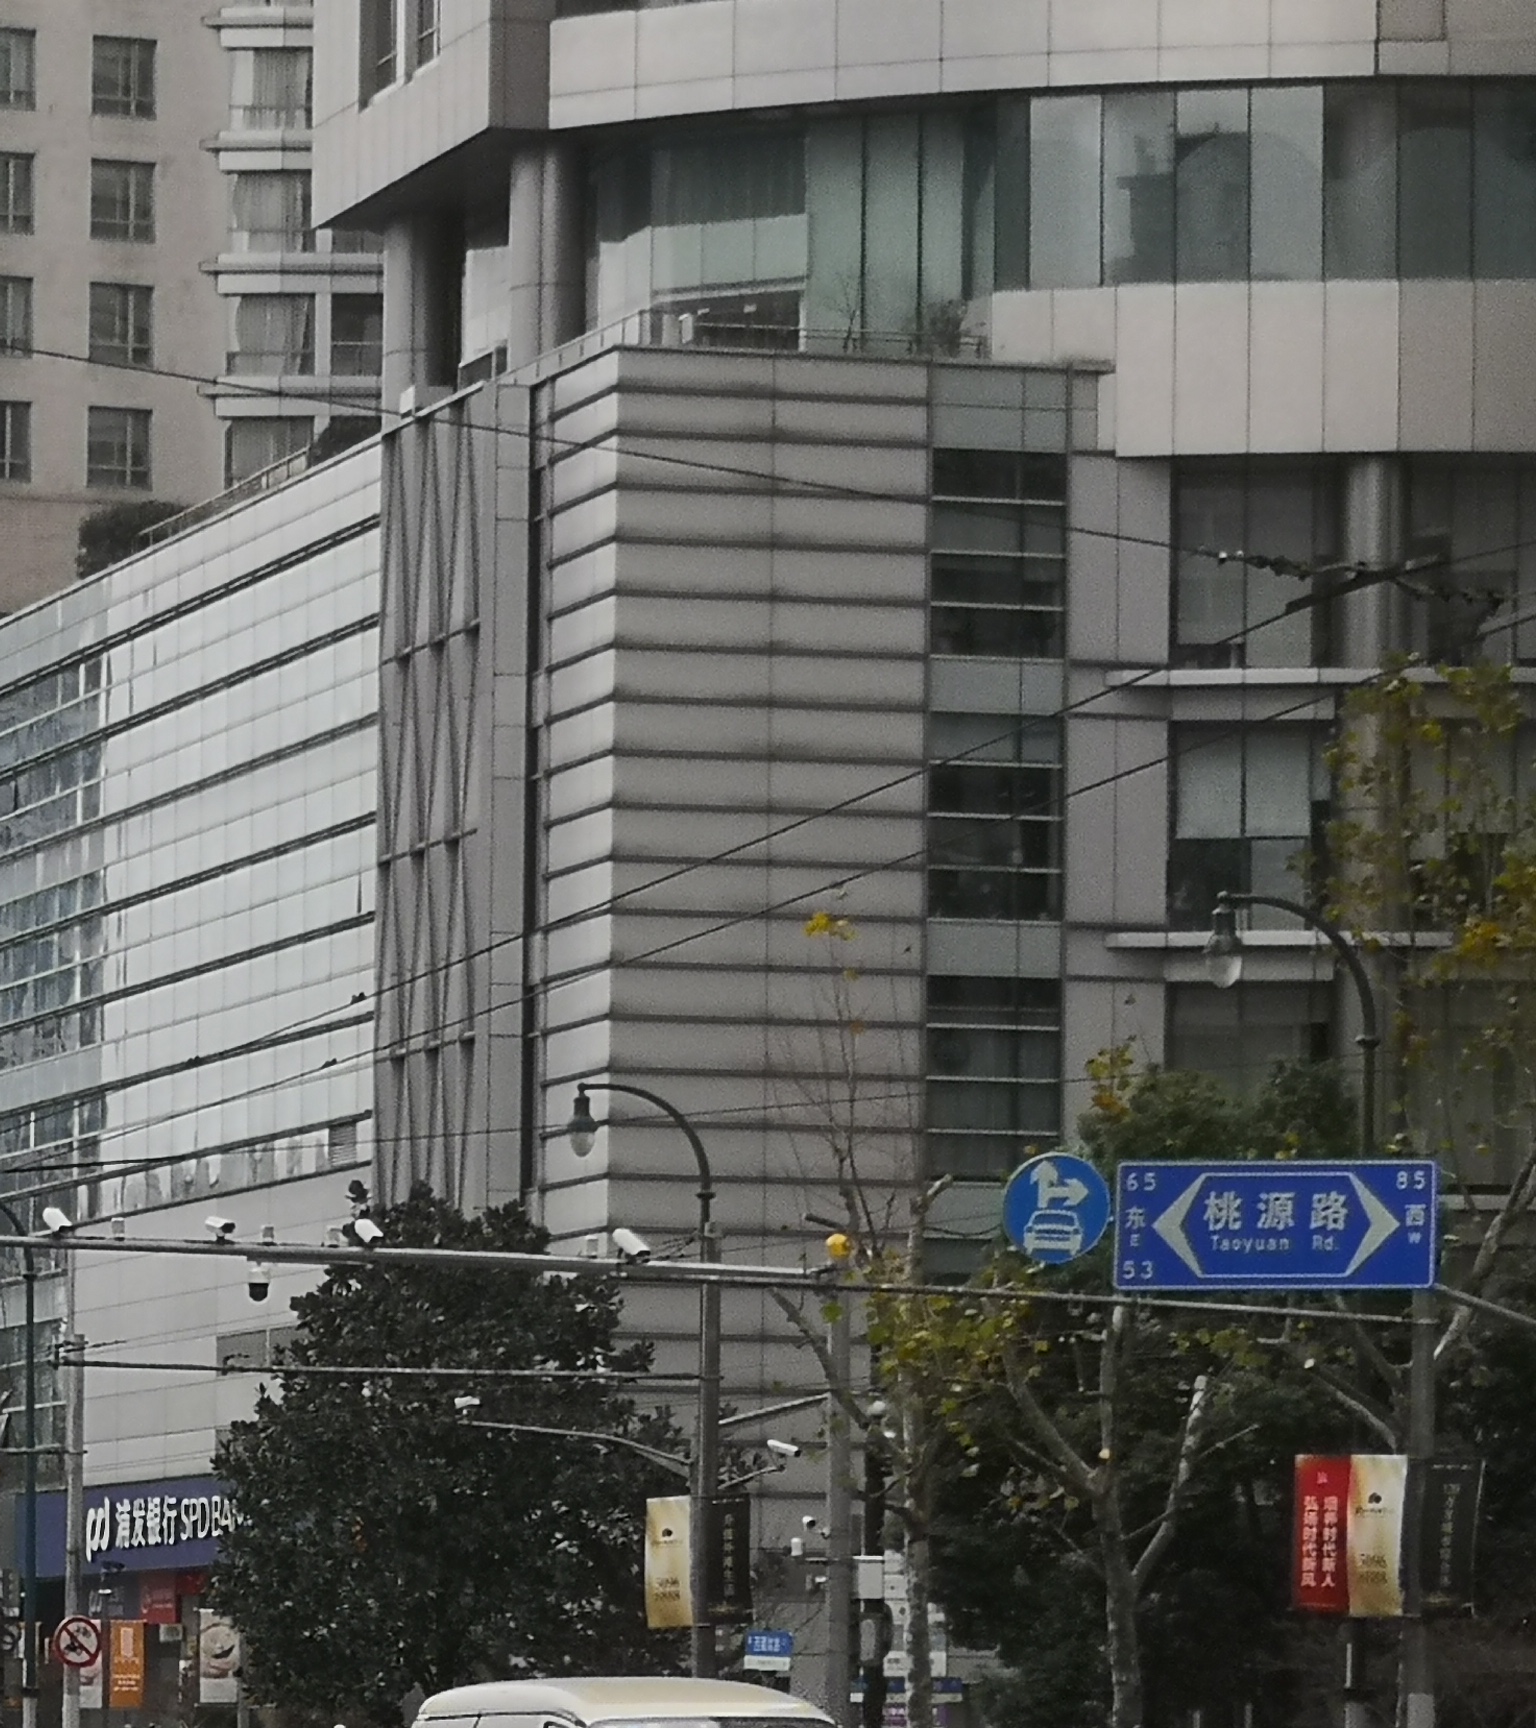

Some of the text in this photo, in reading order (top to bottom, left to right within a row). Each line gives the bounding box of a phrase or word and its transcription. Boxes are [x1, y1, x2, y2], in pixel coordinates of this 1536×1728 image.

[1125, 1172, 1157, 1192] 65
[1395, 1170, 1427, 1191] 85
[1124, 1206, 1146, 1231] 东
[1203, 1190, 1349, 1231] 桃源路
[1404, 1203, 1427, 1228] 西
[1210, 1234, 1340, 1255] Taoyuan Rd.
[1122, 1260, 1154, 1281] 53
[115, 1495, 178, 1549] 浦发银行
[180, 1496, 210, 1541] SPD
